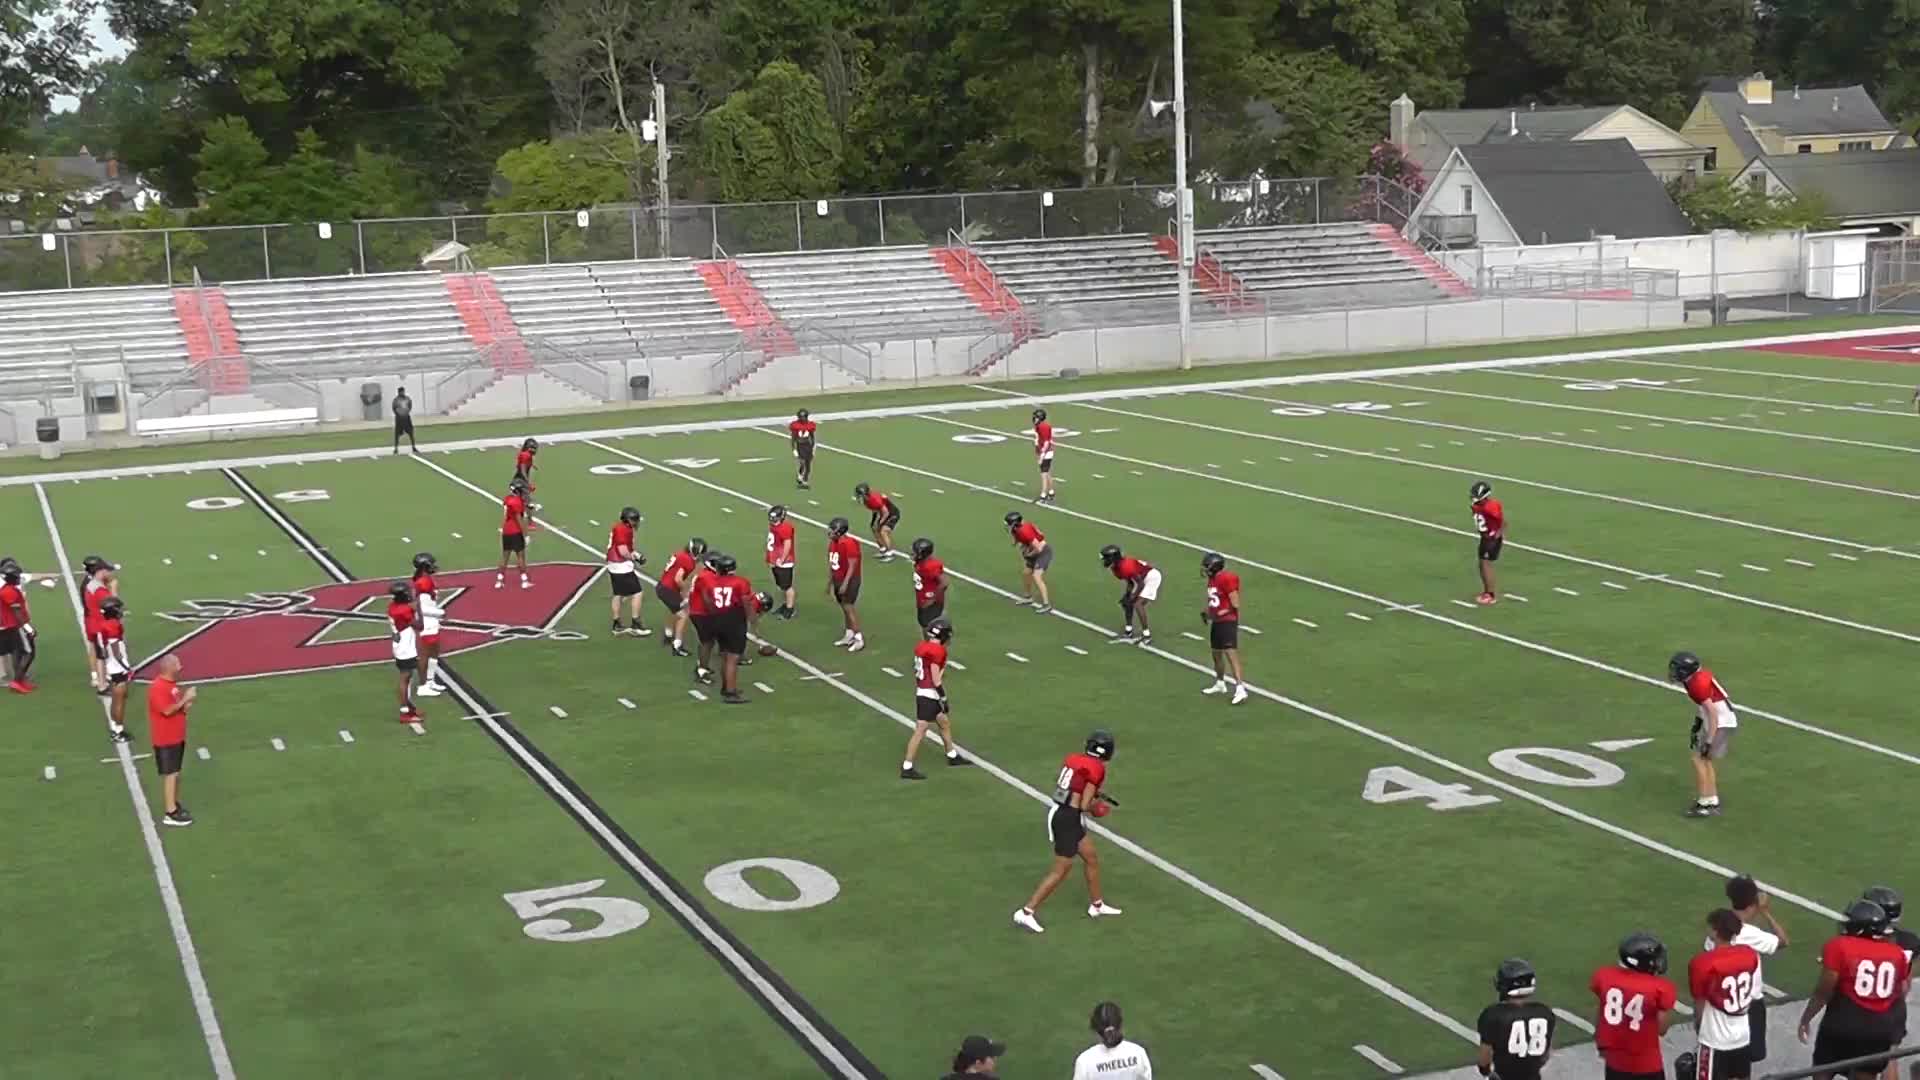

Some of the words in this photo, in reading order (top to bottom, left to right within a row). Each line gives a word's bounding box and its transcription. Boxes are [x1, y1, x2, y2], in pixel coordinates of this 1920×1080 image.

[589, 457, 721, 475] 40
[186, 489, 331, 510] 50
[713, 586, 733, 609] 57
[1361, 746, 1626, 810] 40
[503, 856, 842, 942] 50
[1721, 970, 1753, 1013] 32
[1854, 959, 1896, 999] 60
[1603, 986, 1645, 1031] 84
[1508, 1017, 1548, 1058] 48
[1095, 1055, 1138, 1073] WHEELER
